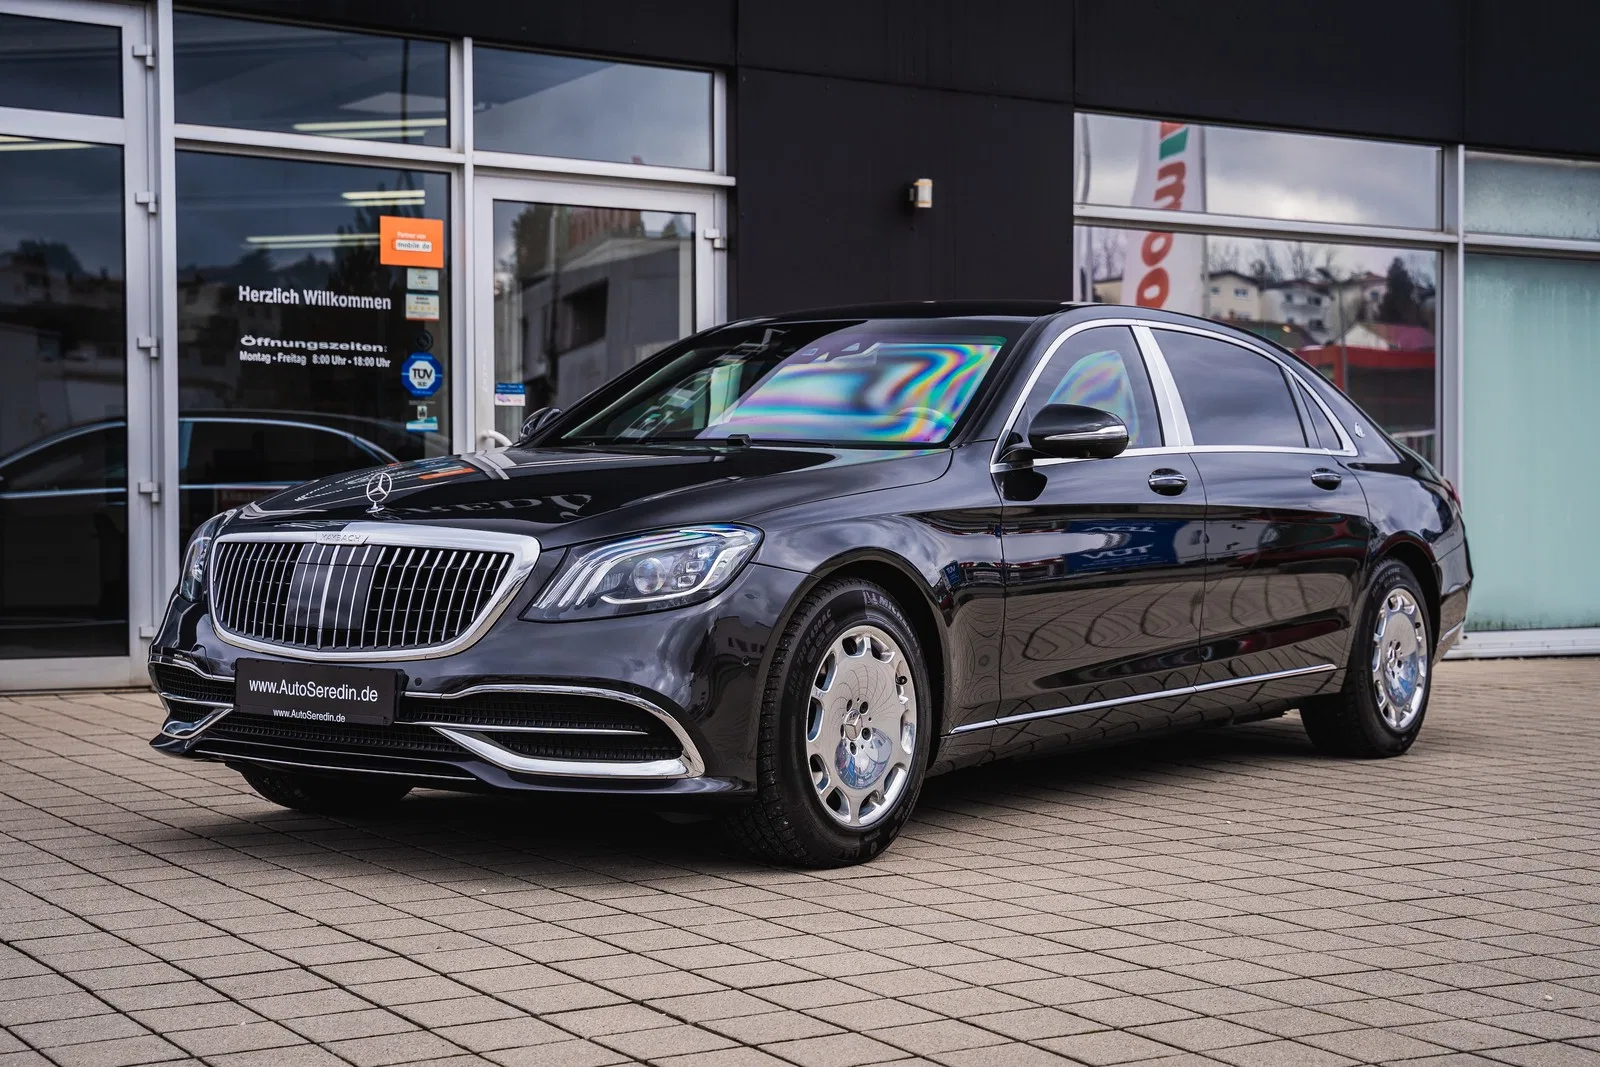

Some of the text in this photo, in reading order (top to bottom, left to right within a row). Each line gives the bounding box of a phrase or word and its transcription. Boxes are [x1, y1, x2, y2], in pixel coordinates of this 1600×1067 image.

[238, 285, 392, 310] Herzlich Willkommen
[240, 335, 388, 353] Öffnungszeiten:
[239, 350, 272, 365] Montag
[277, 353, 307, 366] Freitag
[312, 354, 330, 365] 8:00
[331, 355, 347, 366] Uhr
[353, 356, 375, 367] 18:00
[375, 357, 391, 368] Uhr
[412, 368, 433, 379] TÜV
[320, 533, 361, 542] MAYBACH
[249, 679, 378, 702] www.AutoSeredin.de
[272, 709, 346, 723] www.AutoSeredin.de
